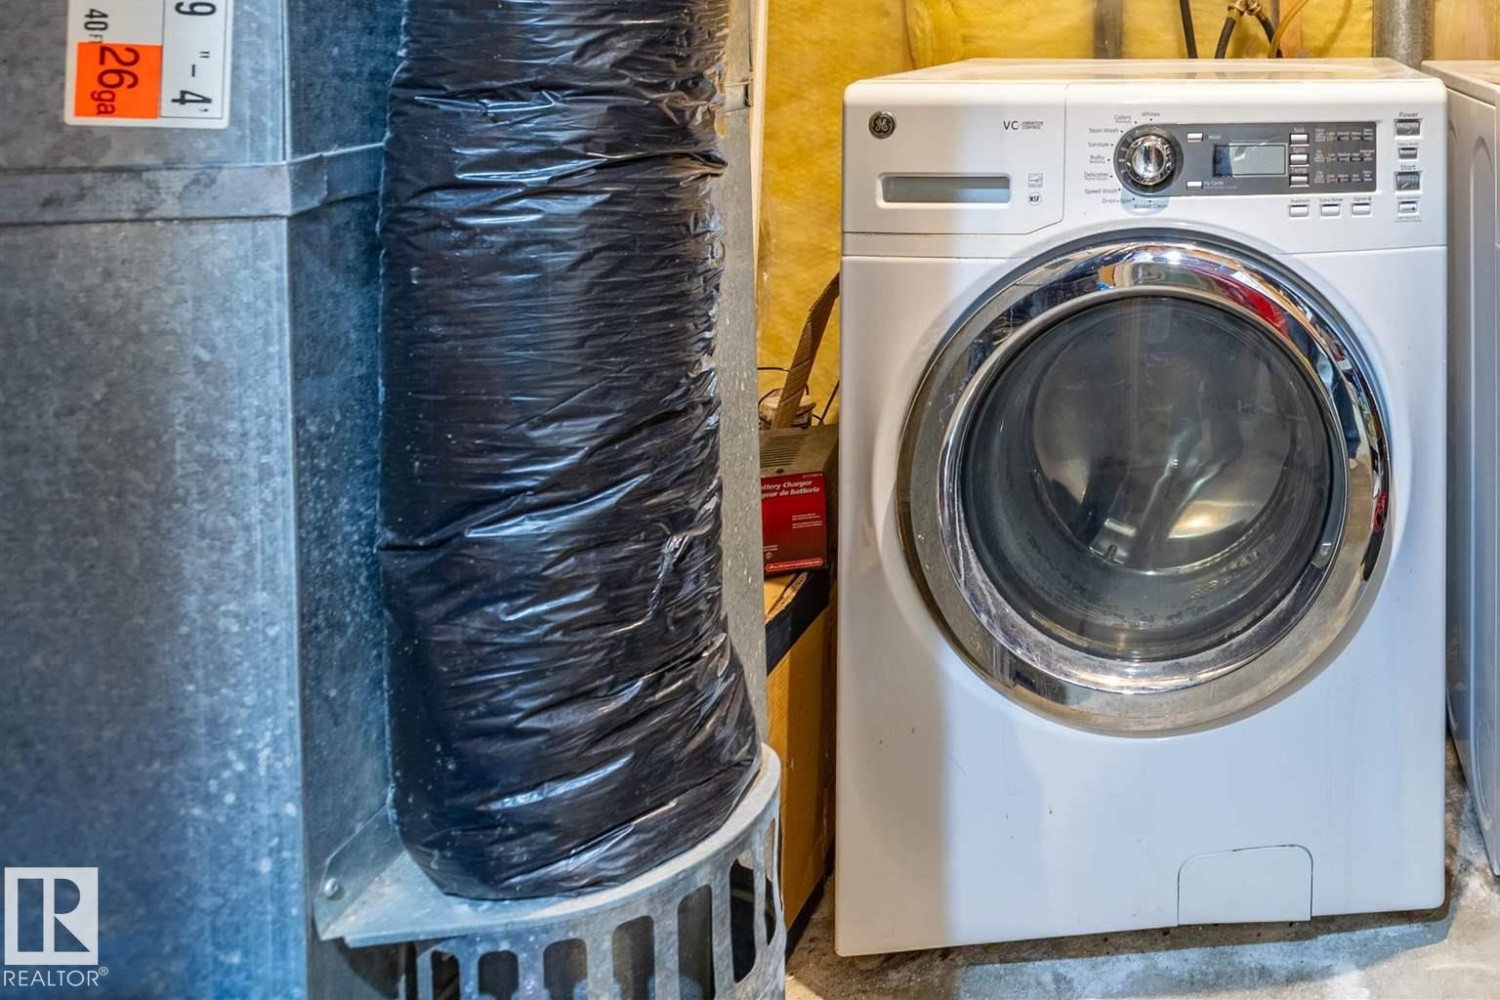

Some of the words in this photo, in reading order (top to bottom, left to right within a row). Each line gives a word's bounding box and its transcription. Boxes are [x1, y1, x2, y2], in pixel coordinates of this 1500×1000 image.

[83, 7, 110, 32] 40
[1003, 120, 1020, 131] VC
[1400, 163, 1417, 171] Start
[783, 480, 813, 490] Charger
[790, 486, 820, 496] batterie
